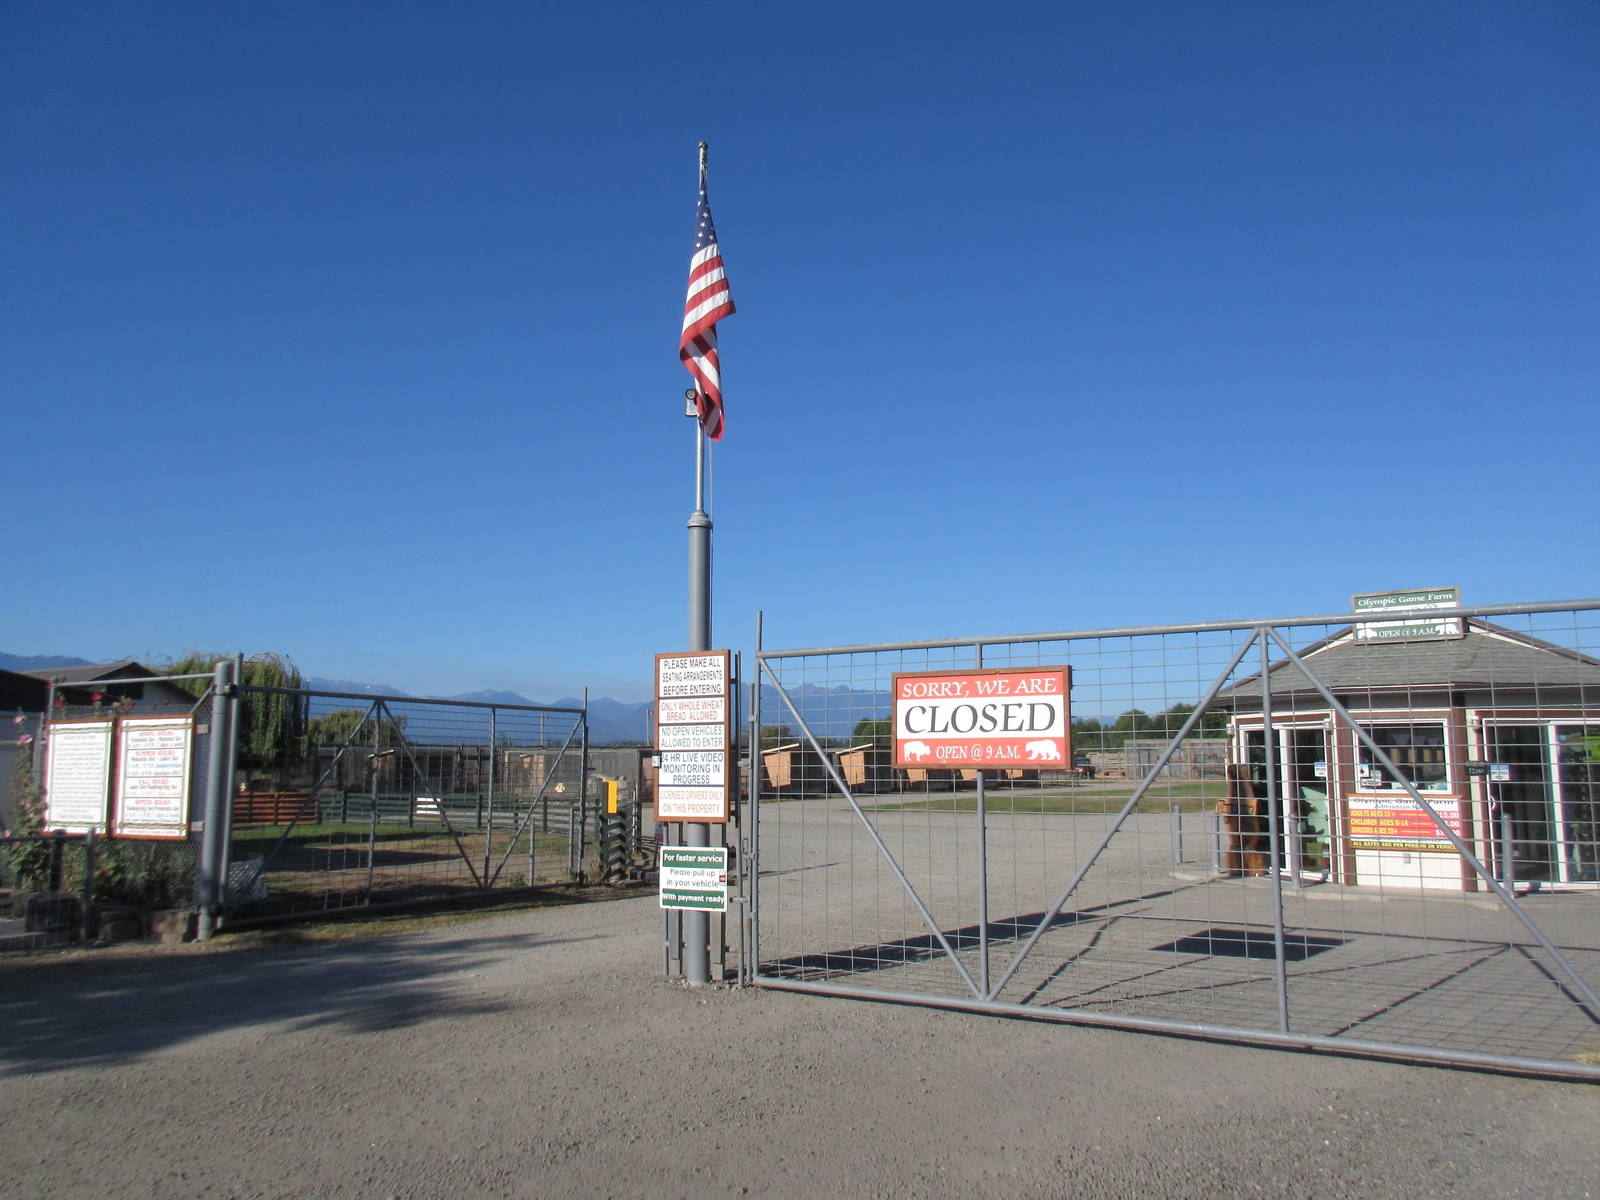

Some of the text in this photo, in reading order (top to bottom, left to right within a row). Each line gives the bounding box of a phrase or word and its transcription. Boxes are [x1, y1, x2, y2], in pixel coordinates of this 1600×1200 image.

[1357, 592, 1453, 608] Olympic Game Farm
[1379, 629, 1401, 638] OPEN
[664, 657, 720, 670] PLEASE MAKE ALL
[662, 670, 722, 682] SEATING ARRANGEMENTS
[664, 684, 721, 696] BEFORE ENTERING
[902, 677, 1057, 698] SORRY, WE ARE
[661, 700, 723, 711] ONLY WHOLE WHEAT
[666, 710, 718, 721] BREAD ALLOWED
[904, 702, 1056, 733] CLOSED
[662, 726, 722, 736] NO OPEN VEHICLES
[661, 738, 723, 748] ALLOWED TO ENTER
[661, 752, 723, 762] 24 HR LIVE VIDEO
[936, 744, 1021, 761] OPEN @ 9 A.M.
[663, 764, 720, 774] MONITORING IN
[672, 774, 710, 784] PROGRESS
[660, 790, 722, 800] LICENSED DRIVERS ONLY
[663, 804, 720, 814] ON THIS PROPERTY
[676, 854, 696, 862] faster
[698, 854, 723, 863] service
[670, 868, 691, 876] Please
[692, 869, 705, 877] pull
[692, 880, 719, 888] vehicle
[662, 892, 725, 904] With payment ready
